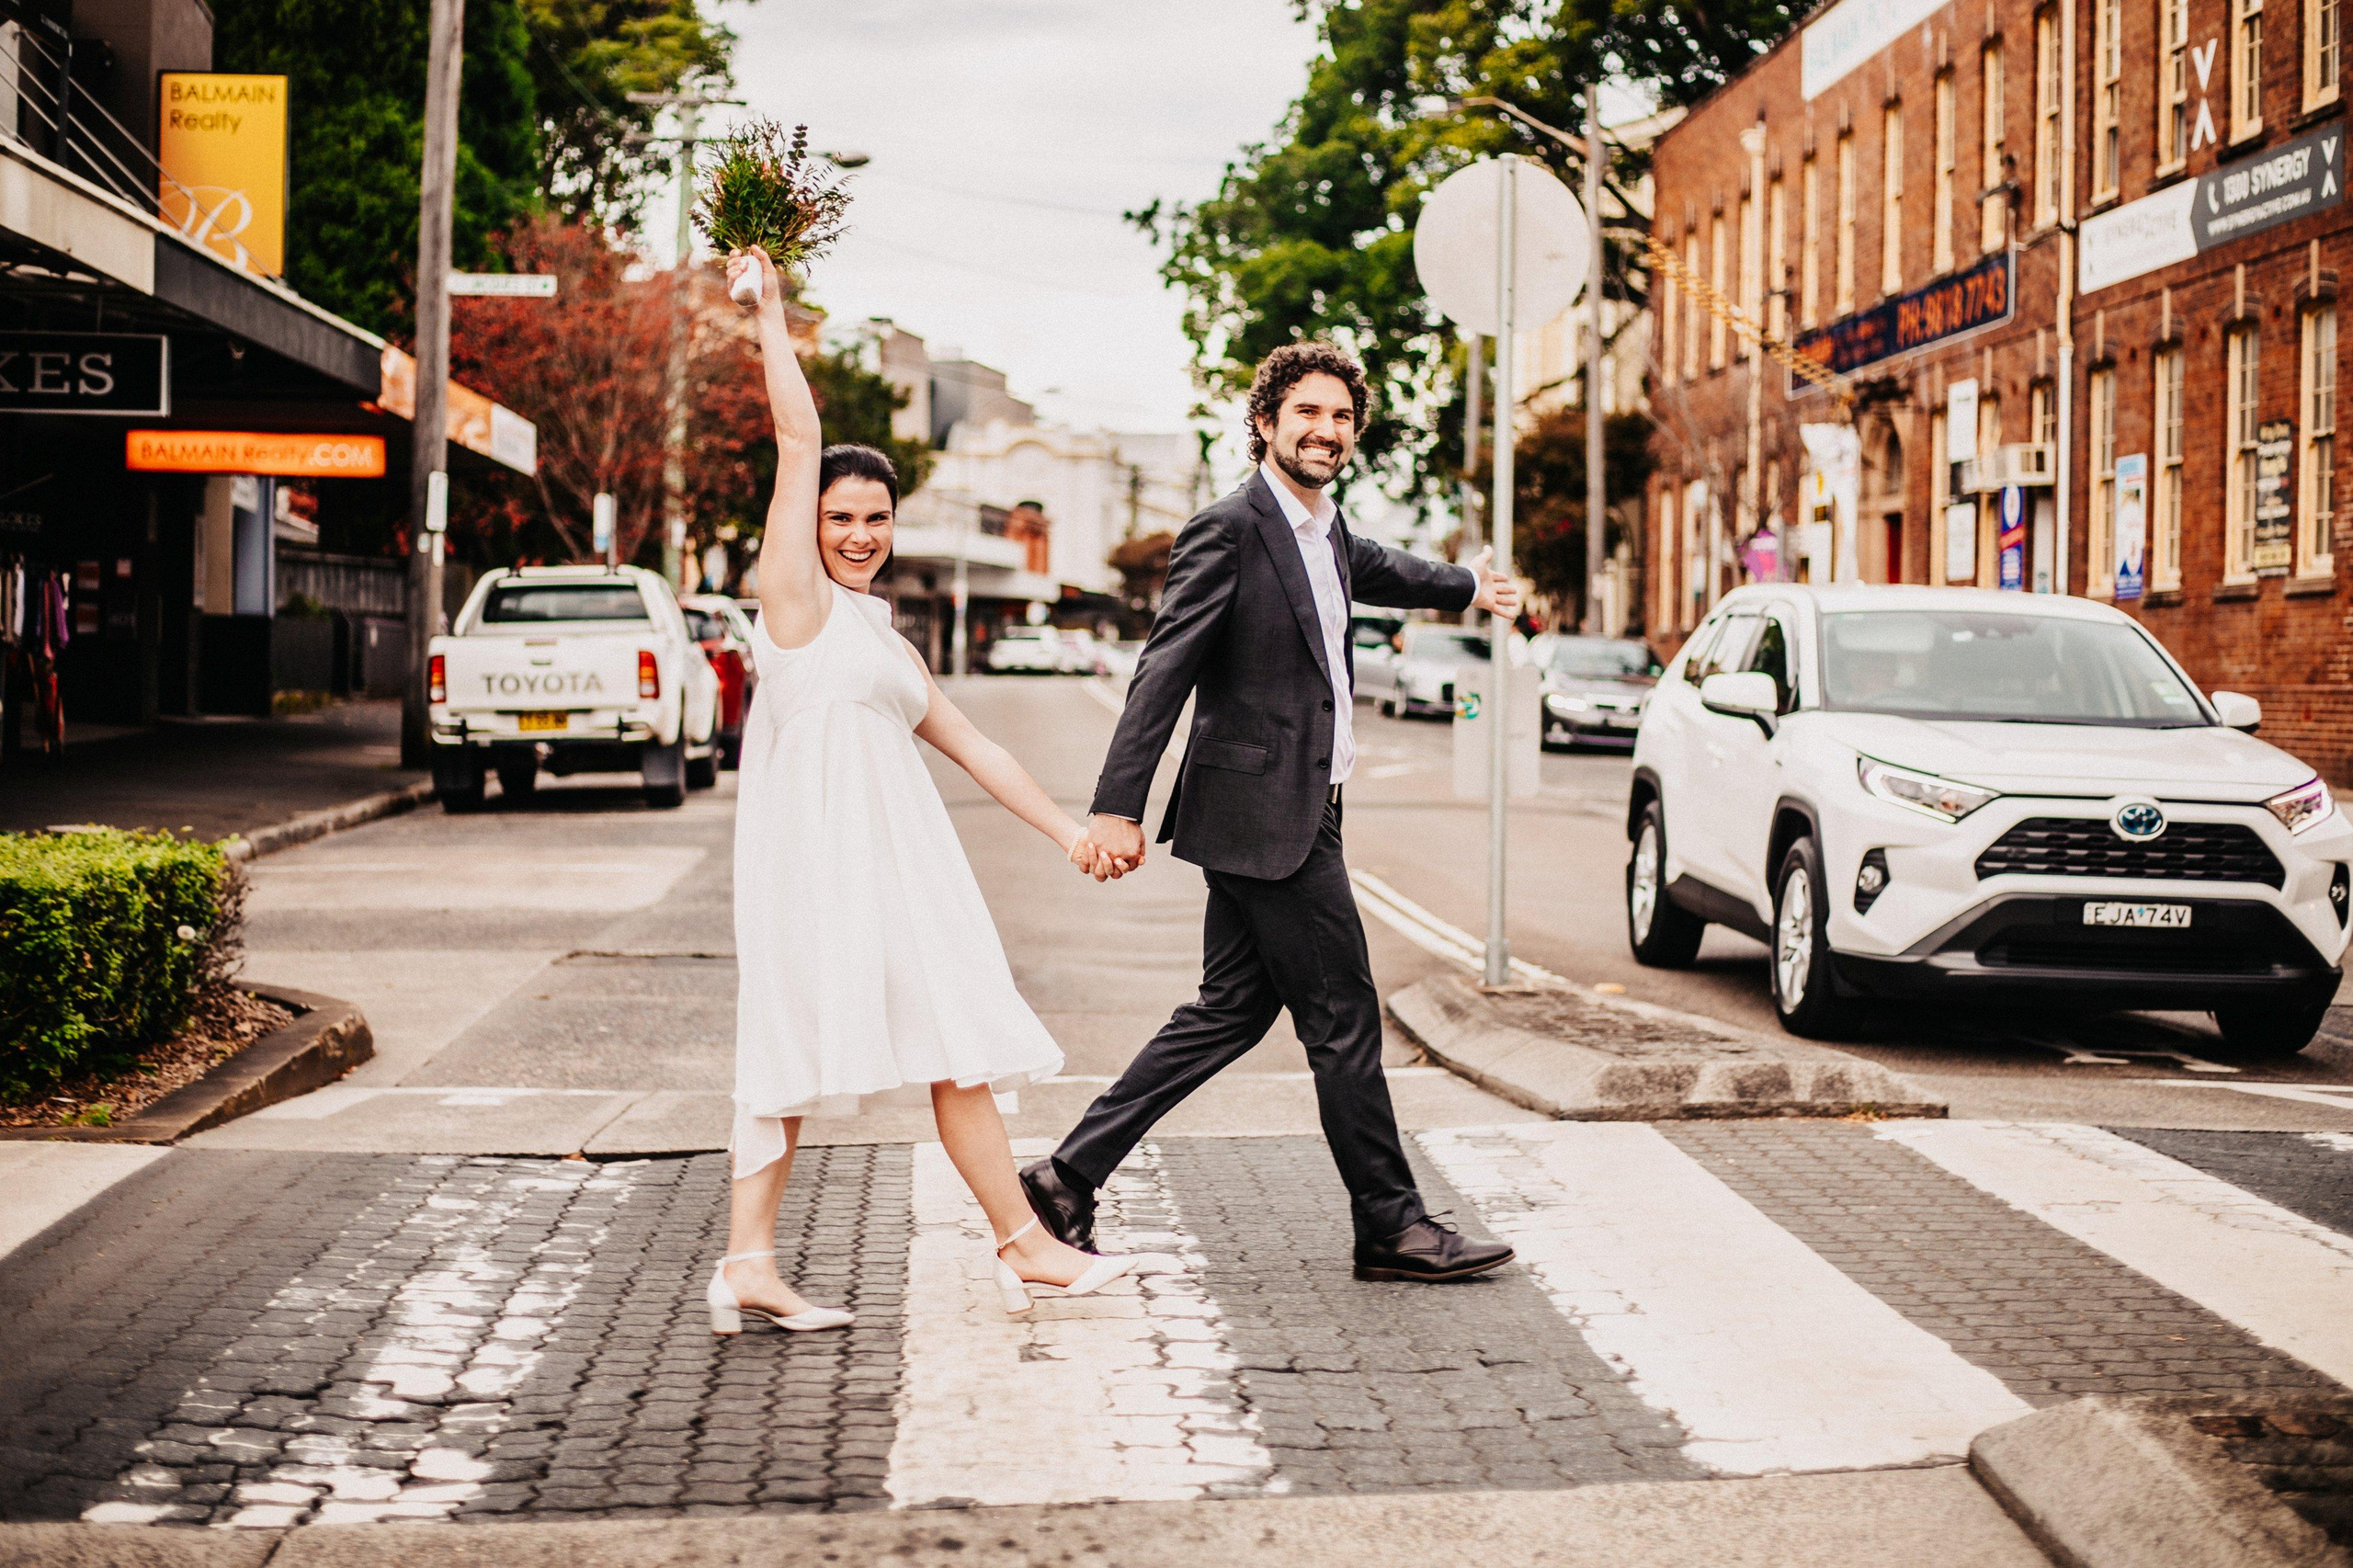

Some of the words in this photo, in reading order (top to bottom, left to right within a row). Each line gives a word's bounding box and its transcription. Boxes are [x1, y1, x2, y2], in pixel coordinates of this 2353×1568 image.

[169, 81, 276, 105] BALMAIN
[169, 108, 242, 135] Realty
[2251, 146, 2312, 196] SYNERGY
[141, 439, 235, 461] BALMAIN
[482, 672, 604, 694] TOYOTA
